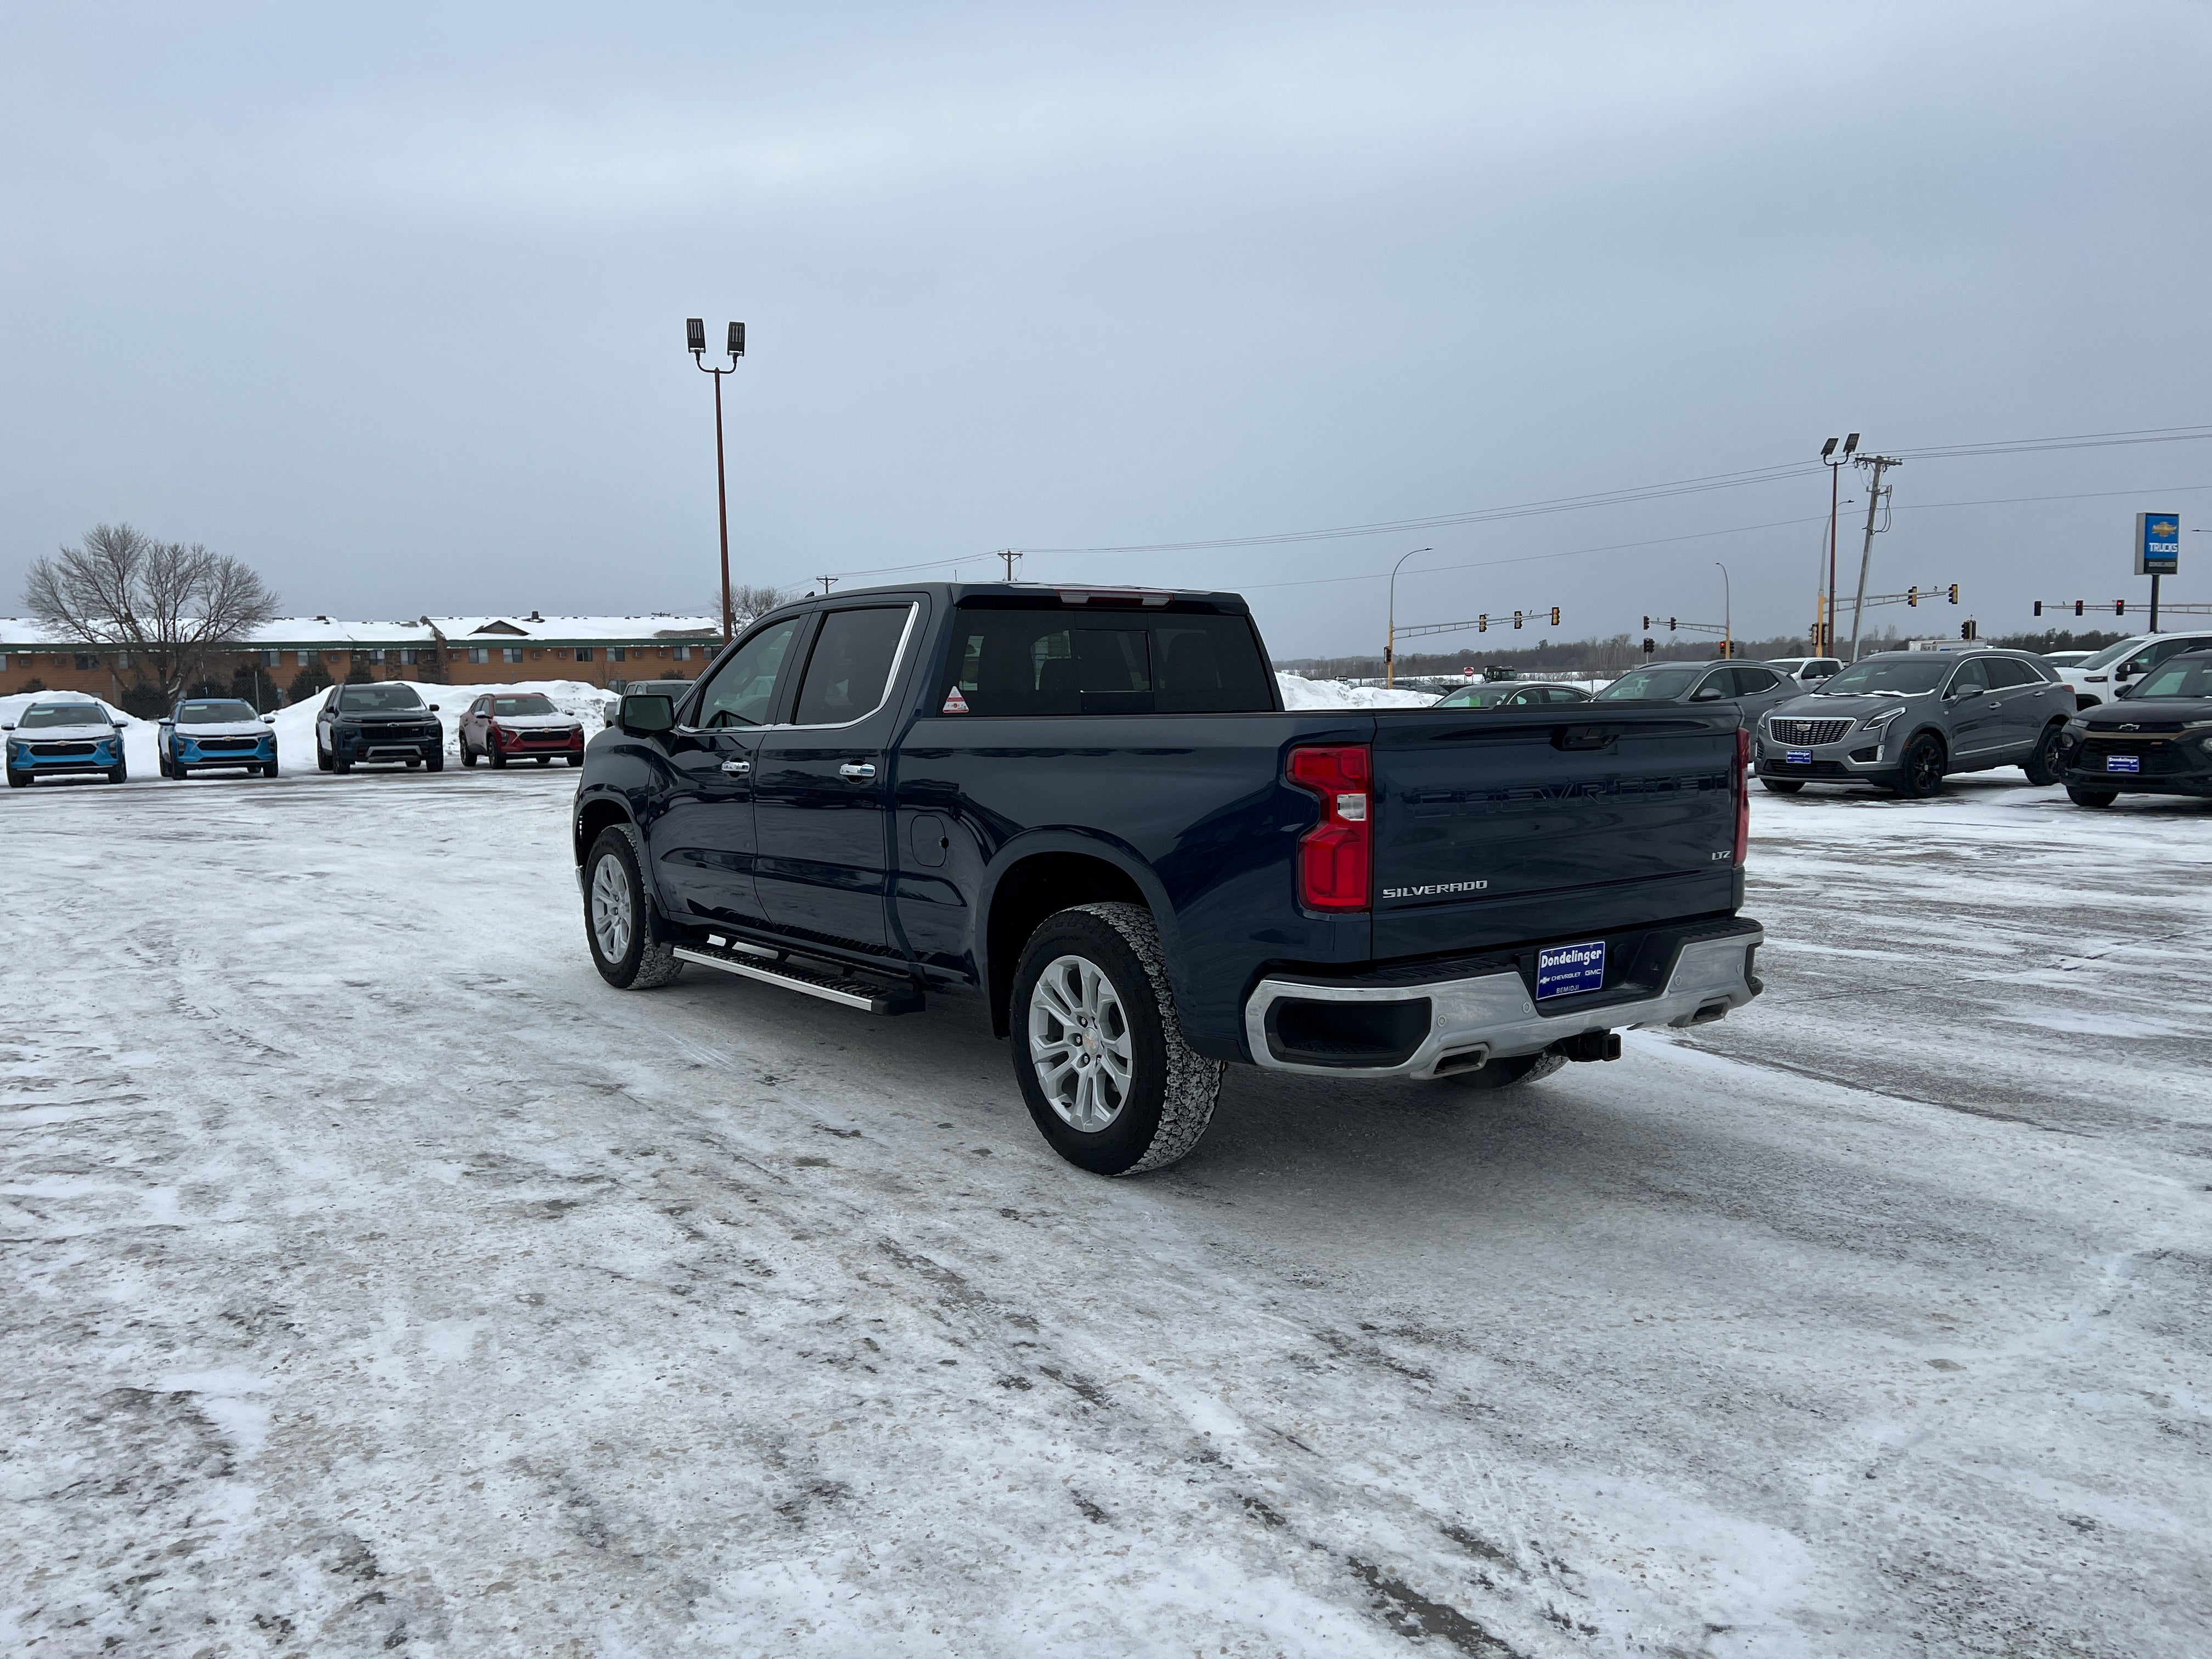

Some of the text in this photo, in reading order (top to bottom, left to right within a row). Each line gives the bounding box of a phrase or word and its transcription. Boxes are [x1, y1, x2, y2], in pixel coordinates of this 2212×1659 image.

[2149, 543, 2177, 552] TRUCKS
[1712, 850, 1731, 860] LTZ
[1382, 880, 1488, 899] SILVERADO
[1541, 950, 1602, 968] Dondelinger
[1551, 972, 1581, 981] CHEVROLET
[1556, 984, 1579, 994] BEMIDJI
